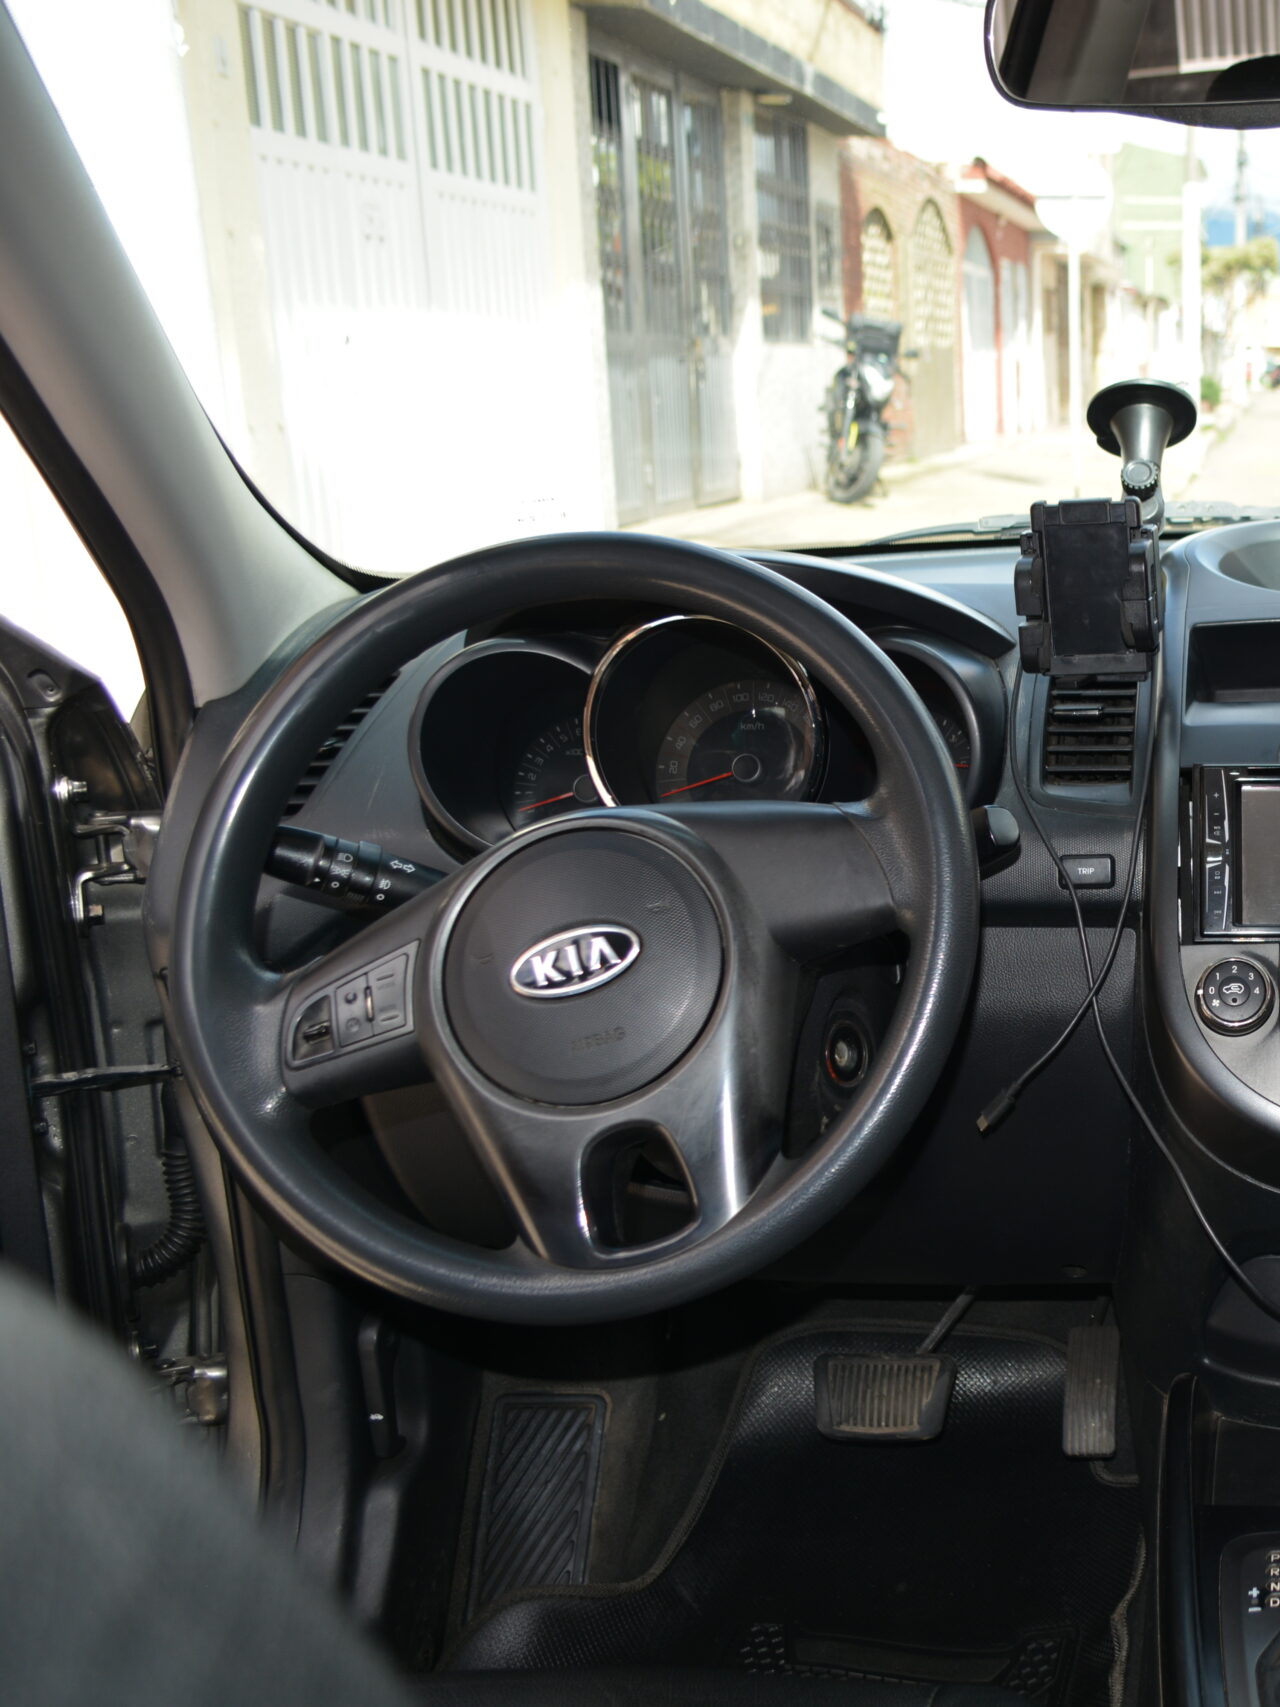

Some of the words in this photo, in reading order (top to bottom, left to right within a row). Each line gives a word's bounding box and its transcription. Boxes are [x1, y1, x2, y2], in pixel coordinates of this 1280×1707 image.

[740, 722, 765, 730] km/h
[1077, 867, 1095, 875] TRIP
[530, 936, 622, 986] KIA
[1231, 965, 1238, 974] 2
[1248, 972, 1255, 981] 3
[1253, 986, 1261, 995] 4
[1270, 1553, 1280, 1563] P
[1270, 1567, 1280, 1577] R
[1270, 1582, 1280, 1592] N
[1270, 1597, 1280, 1608] D
